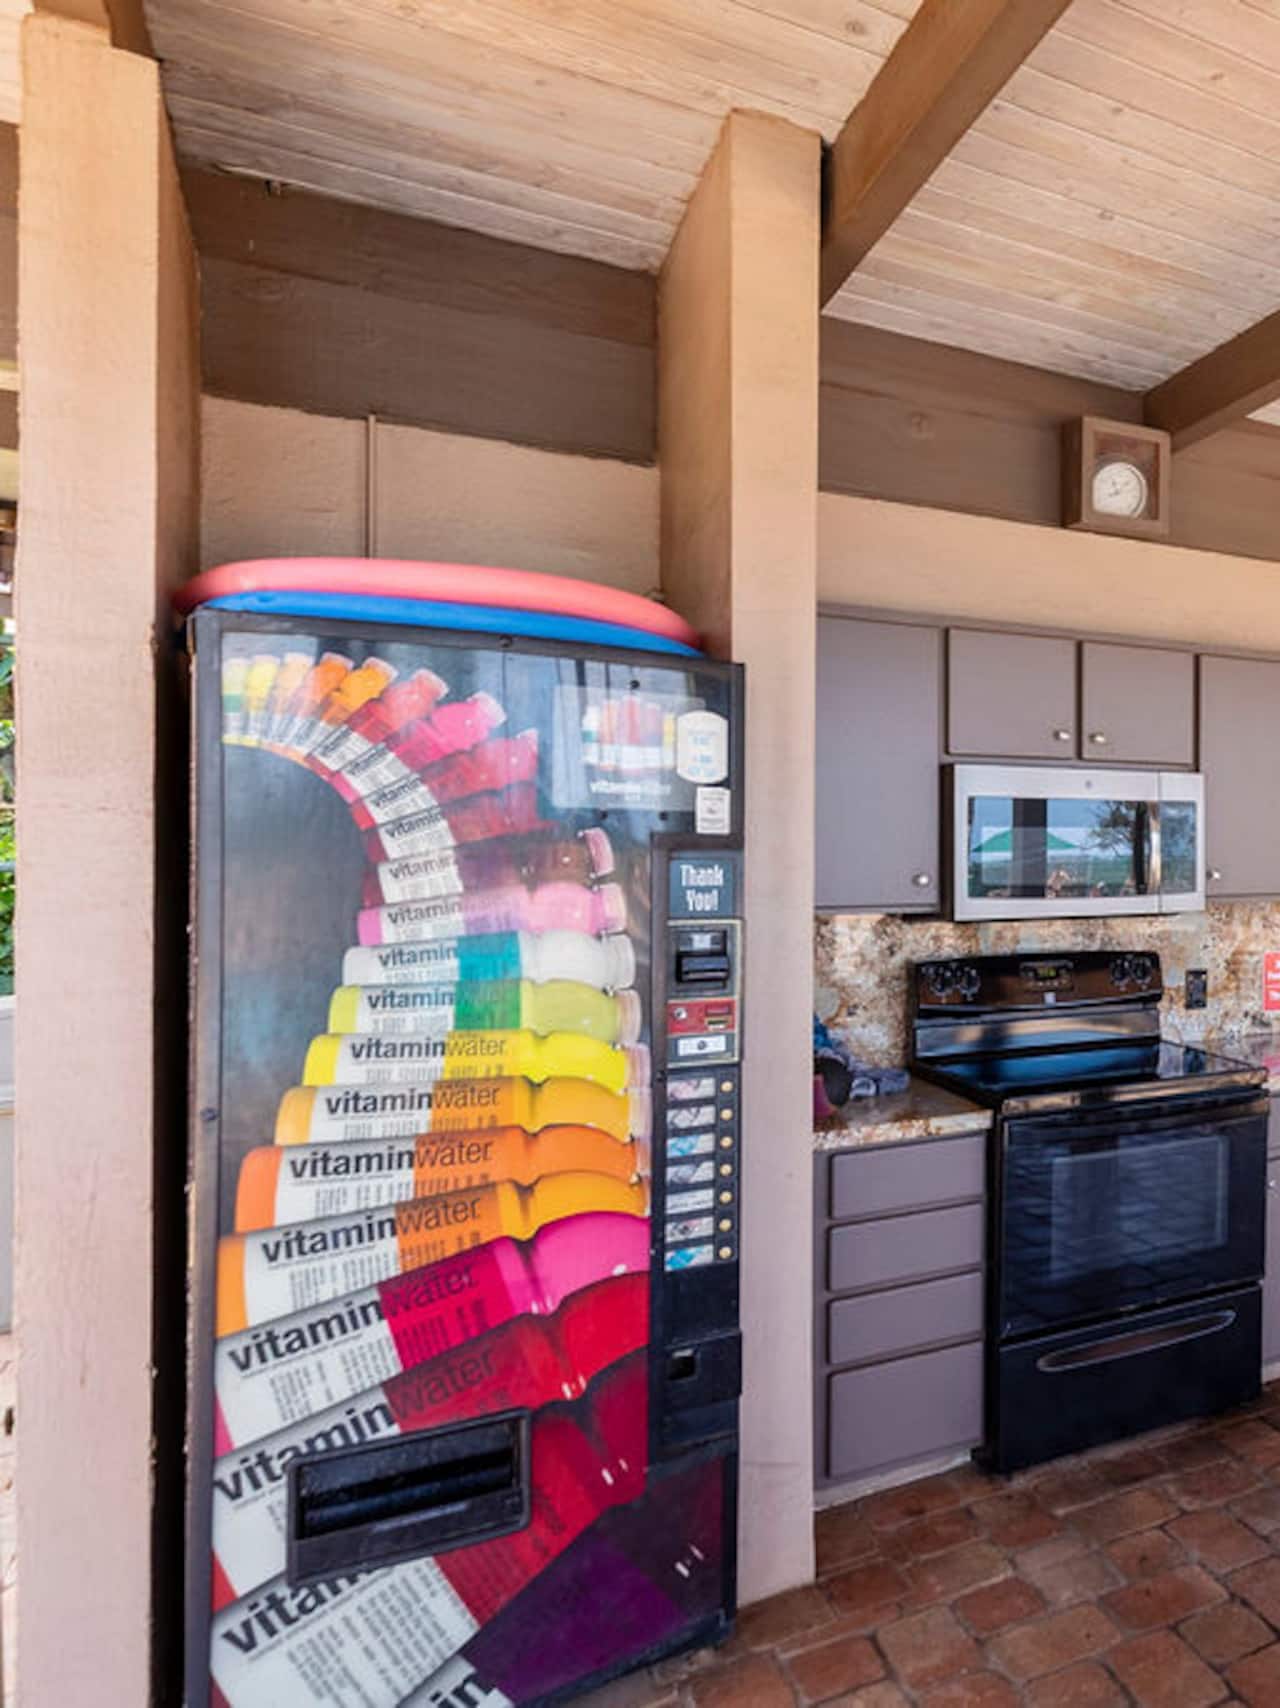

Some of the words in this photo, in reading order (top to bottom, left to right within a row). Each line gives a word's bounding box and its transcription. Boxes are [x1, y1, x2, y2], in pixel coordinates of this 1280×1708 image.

[388, 856, 451, 879] vitamin
[680, 864, 724, 887] Thank
[686, 888, 719, 911] You!
